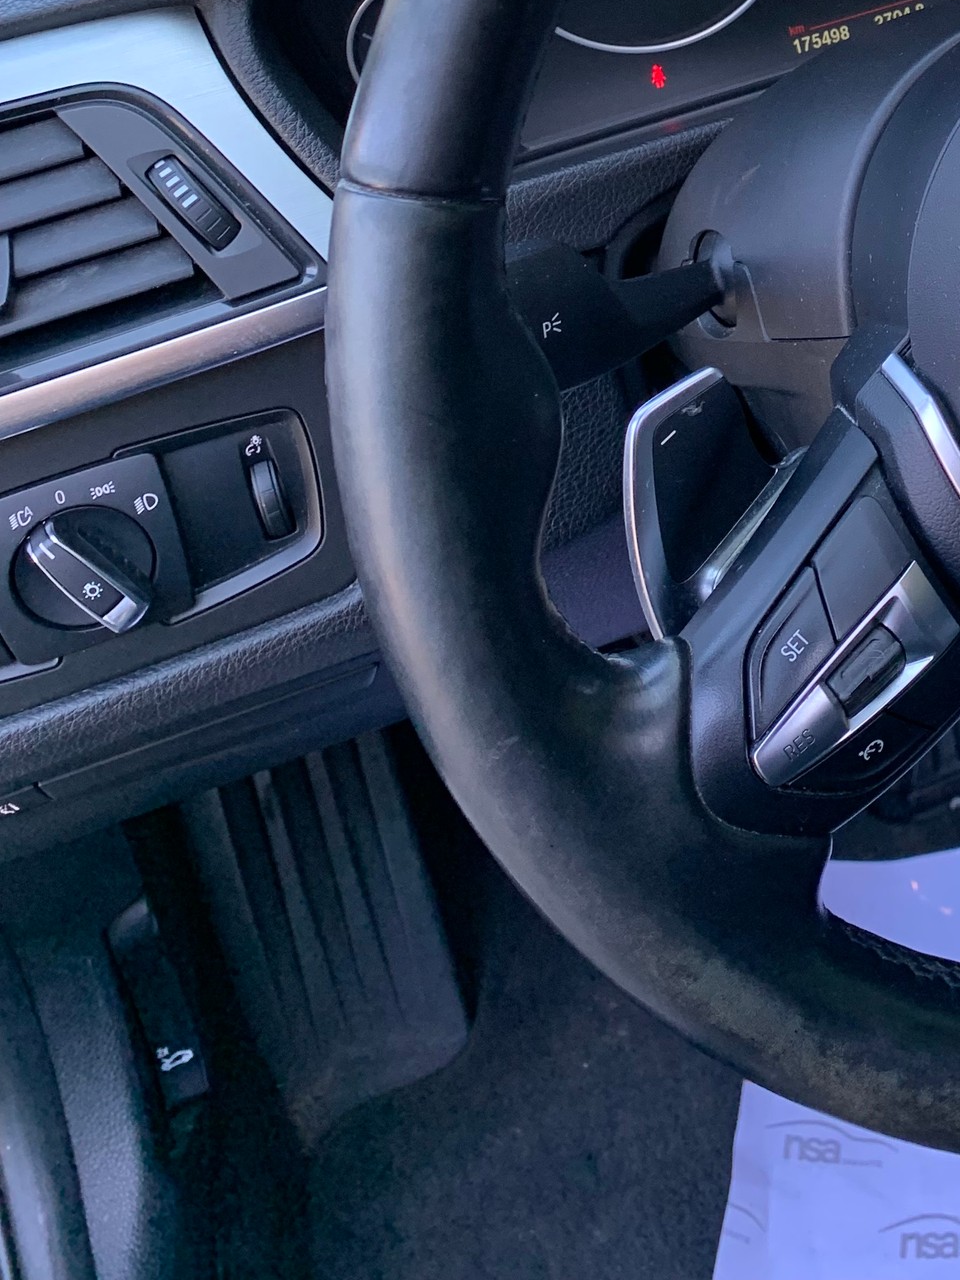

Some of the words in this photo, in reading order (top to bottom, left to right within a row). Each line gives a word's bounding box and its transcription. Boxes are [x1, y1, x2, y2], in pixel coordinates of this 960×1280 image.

[792, 25, 851, 55] 175498
[780, 629, 809, 662] SET
[782, 728, 817, 762] RES
